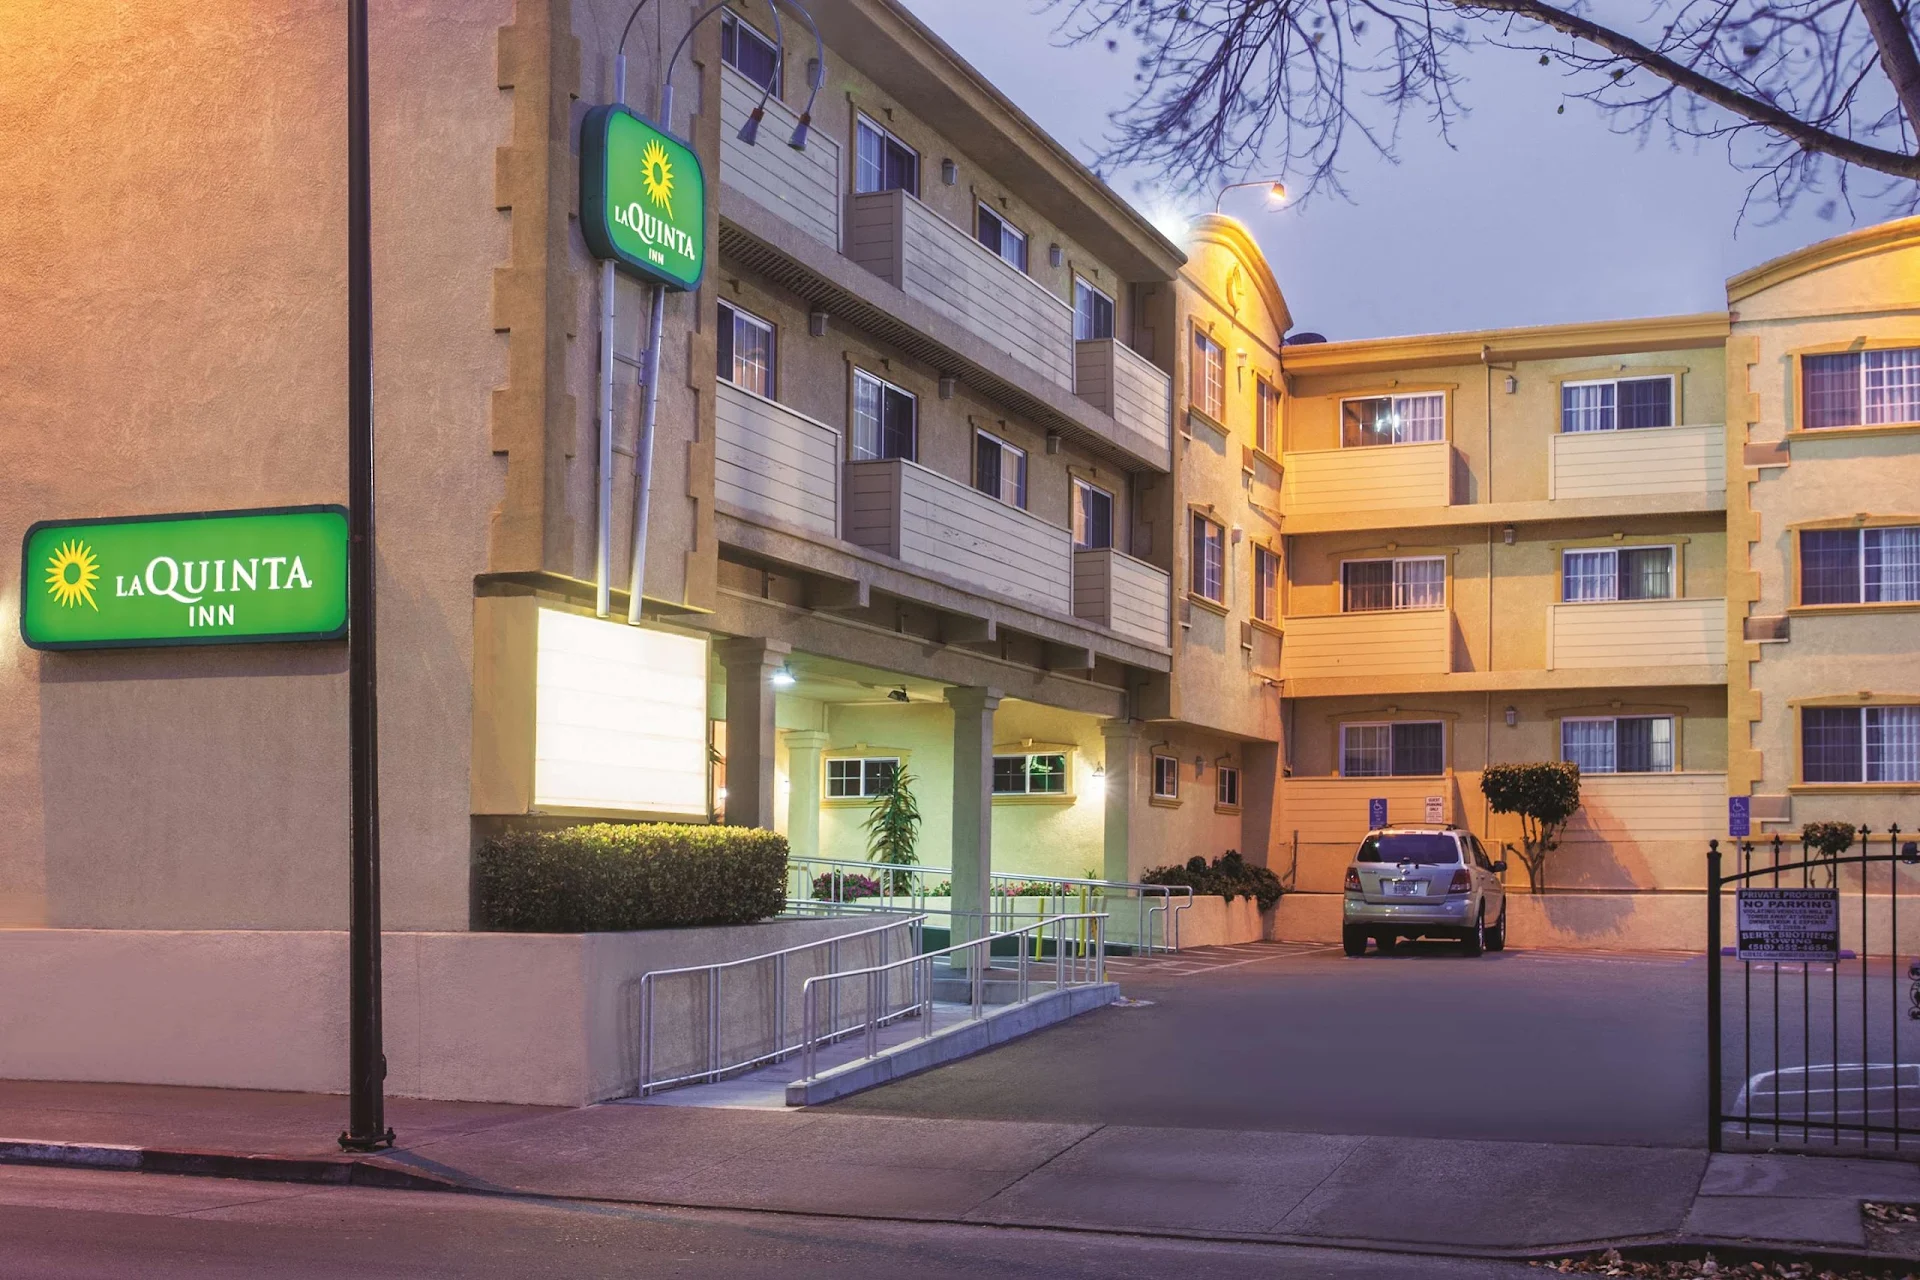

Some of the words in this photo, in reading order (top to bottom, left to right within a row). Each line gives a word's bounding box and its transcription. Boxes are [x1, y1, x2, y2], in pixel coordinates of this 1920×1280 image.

[628, 202, 696, 261] QUINTA
[648, 248, 664, 266] INN
[144, 554, 313, 604] QUINTA
[188, 603, 235, 628] INN
[1742, 891, 1780, 899] PRIVATE
[1783, 891, 1832, 899] PROPERTY
[1742, 932, 1776, 940] BERRY
[1778, 931, 1835, 940] BROTHERS
[1748, 943, 1775, 951] (510)
